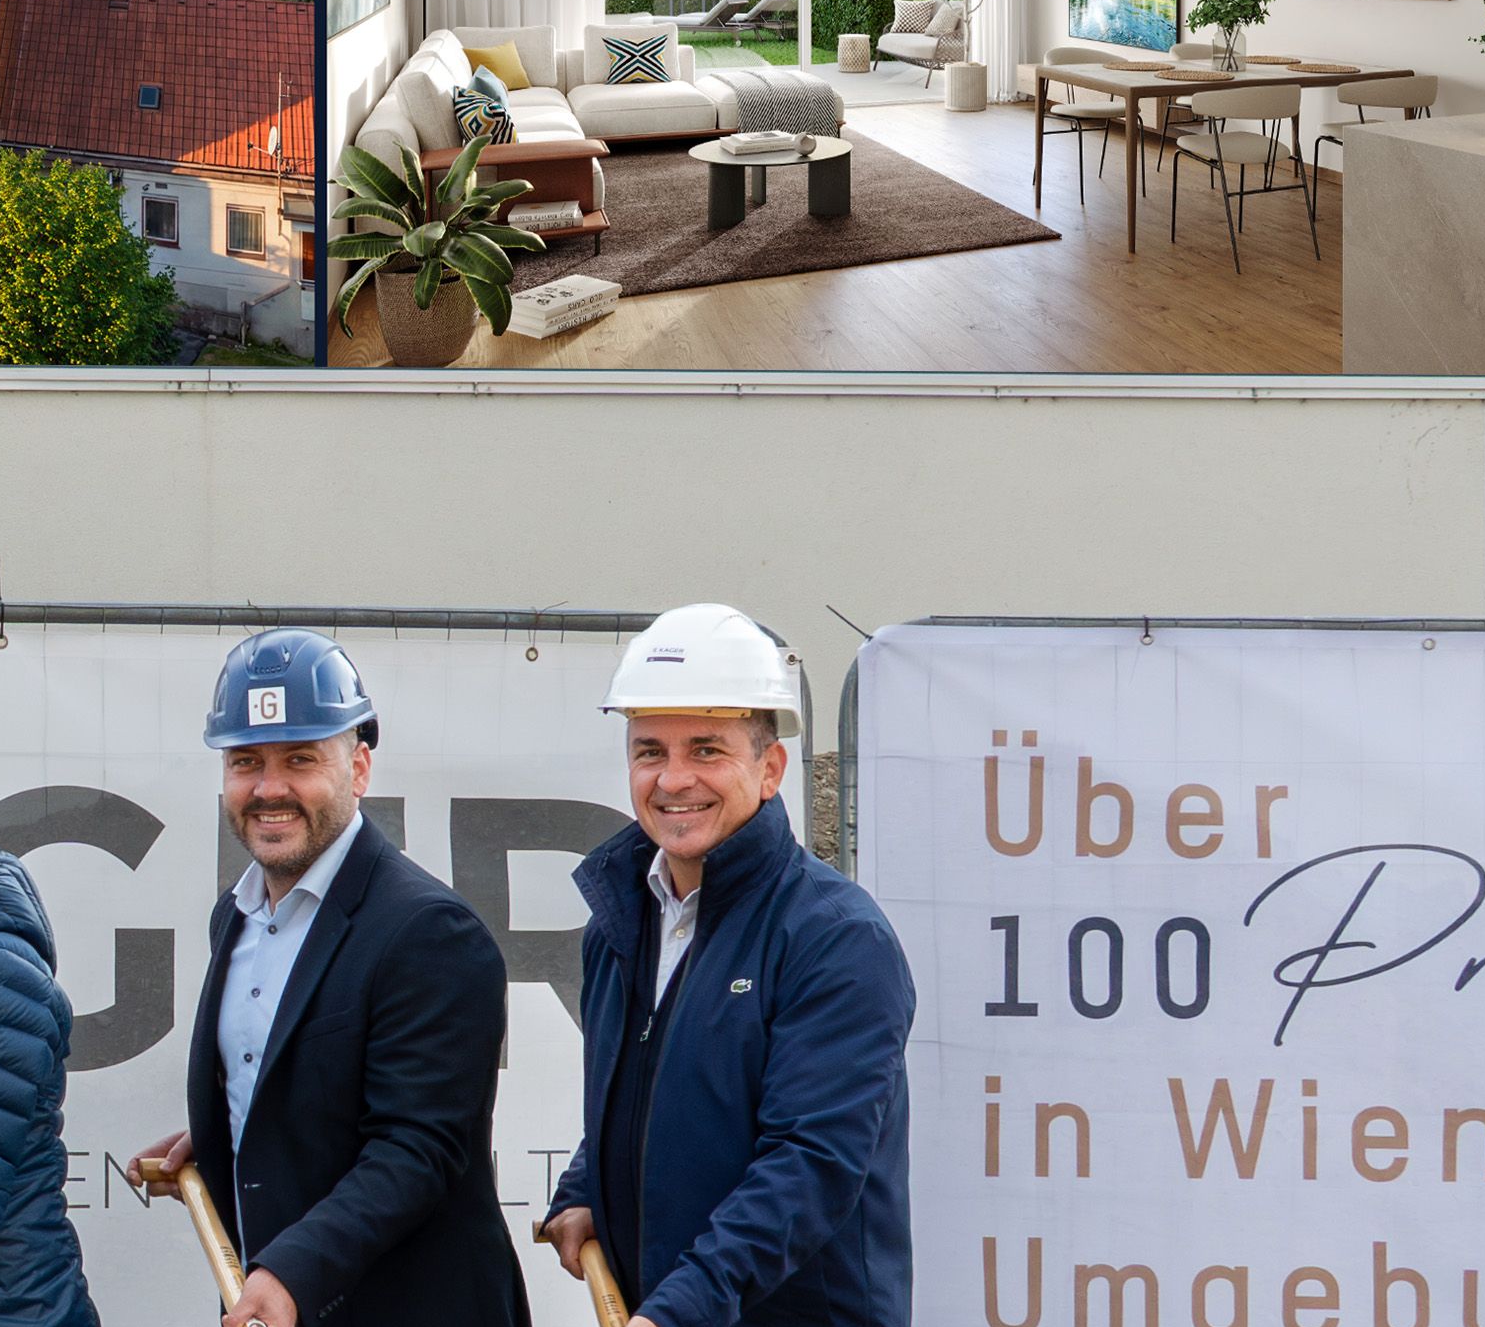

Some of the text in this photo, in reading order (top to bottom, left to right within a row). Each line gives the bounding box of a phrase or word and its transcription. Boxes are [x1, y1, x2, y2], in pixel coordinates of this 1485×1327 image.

[984, 730, 1288, 858] Über
[985, 915, 1211, 1019] 100
[985, 1076, 1091, 1178] in
